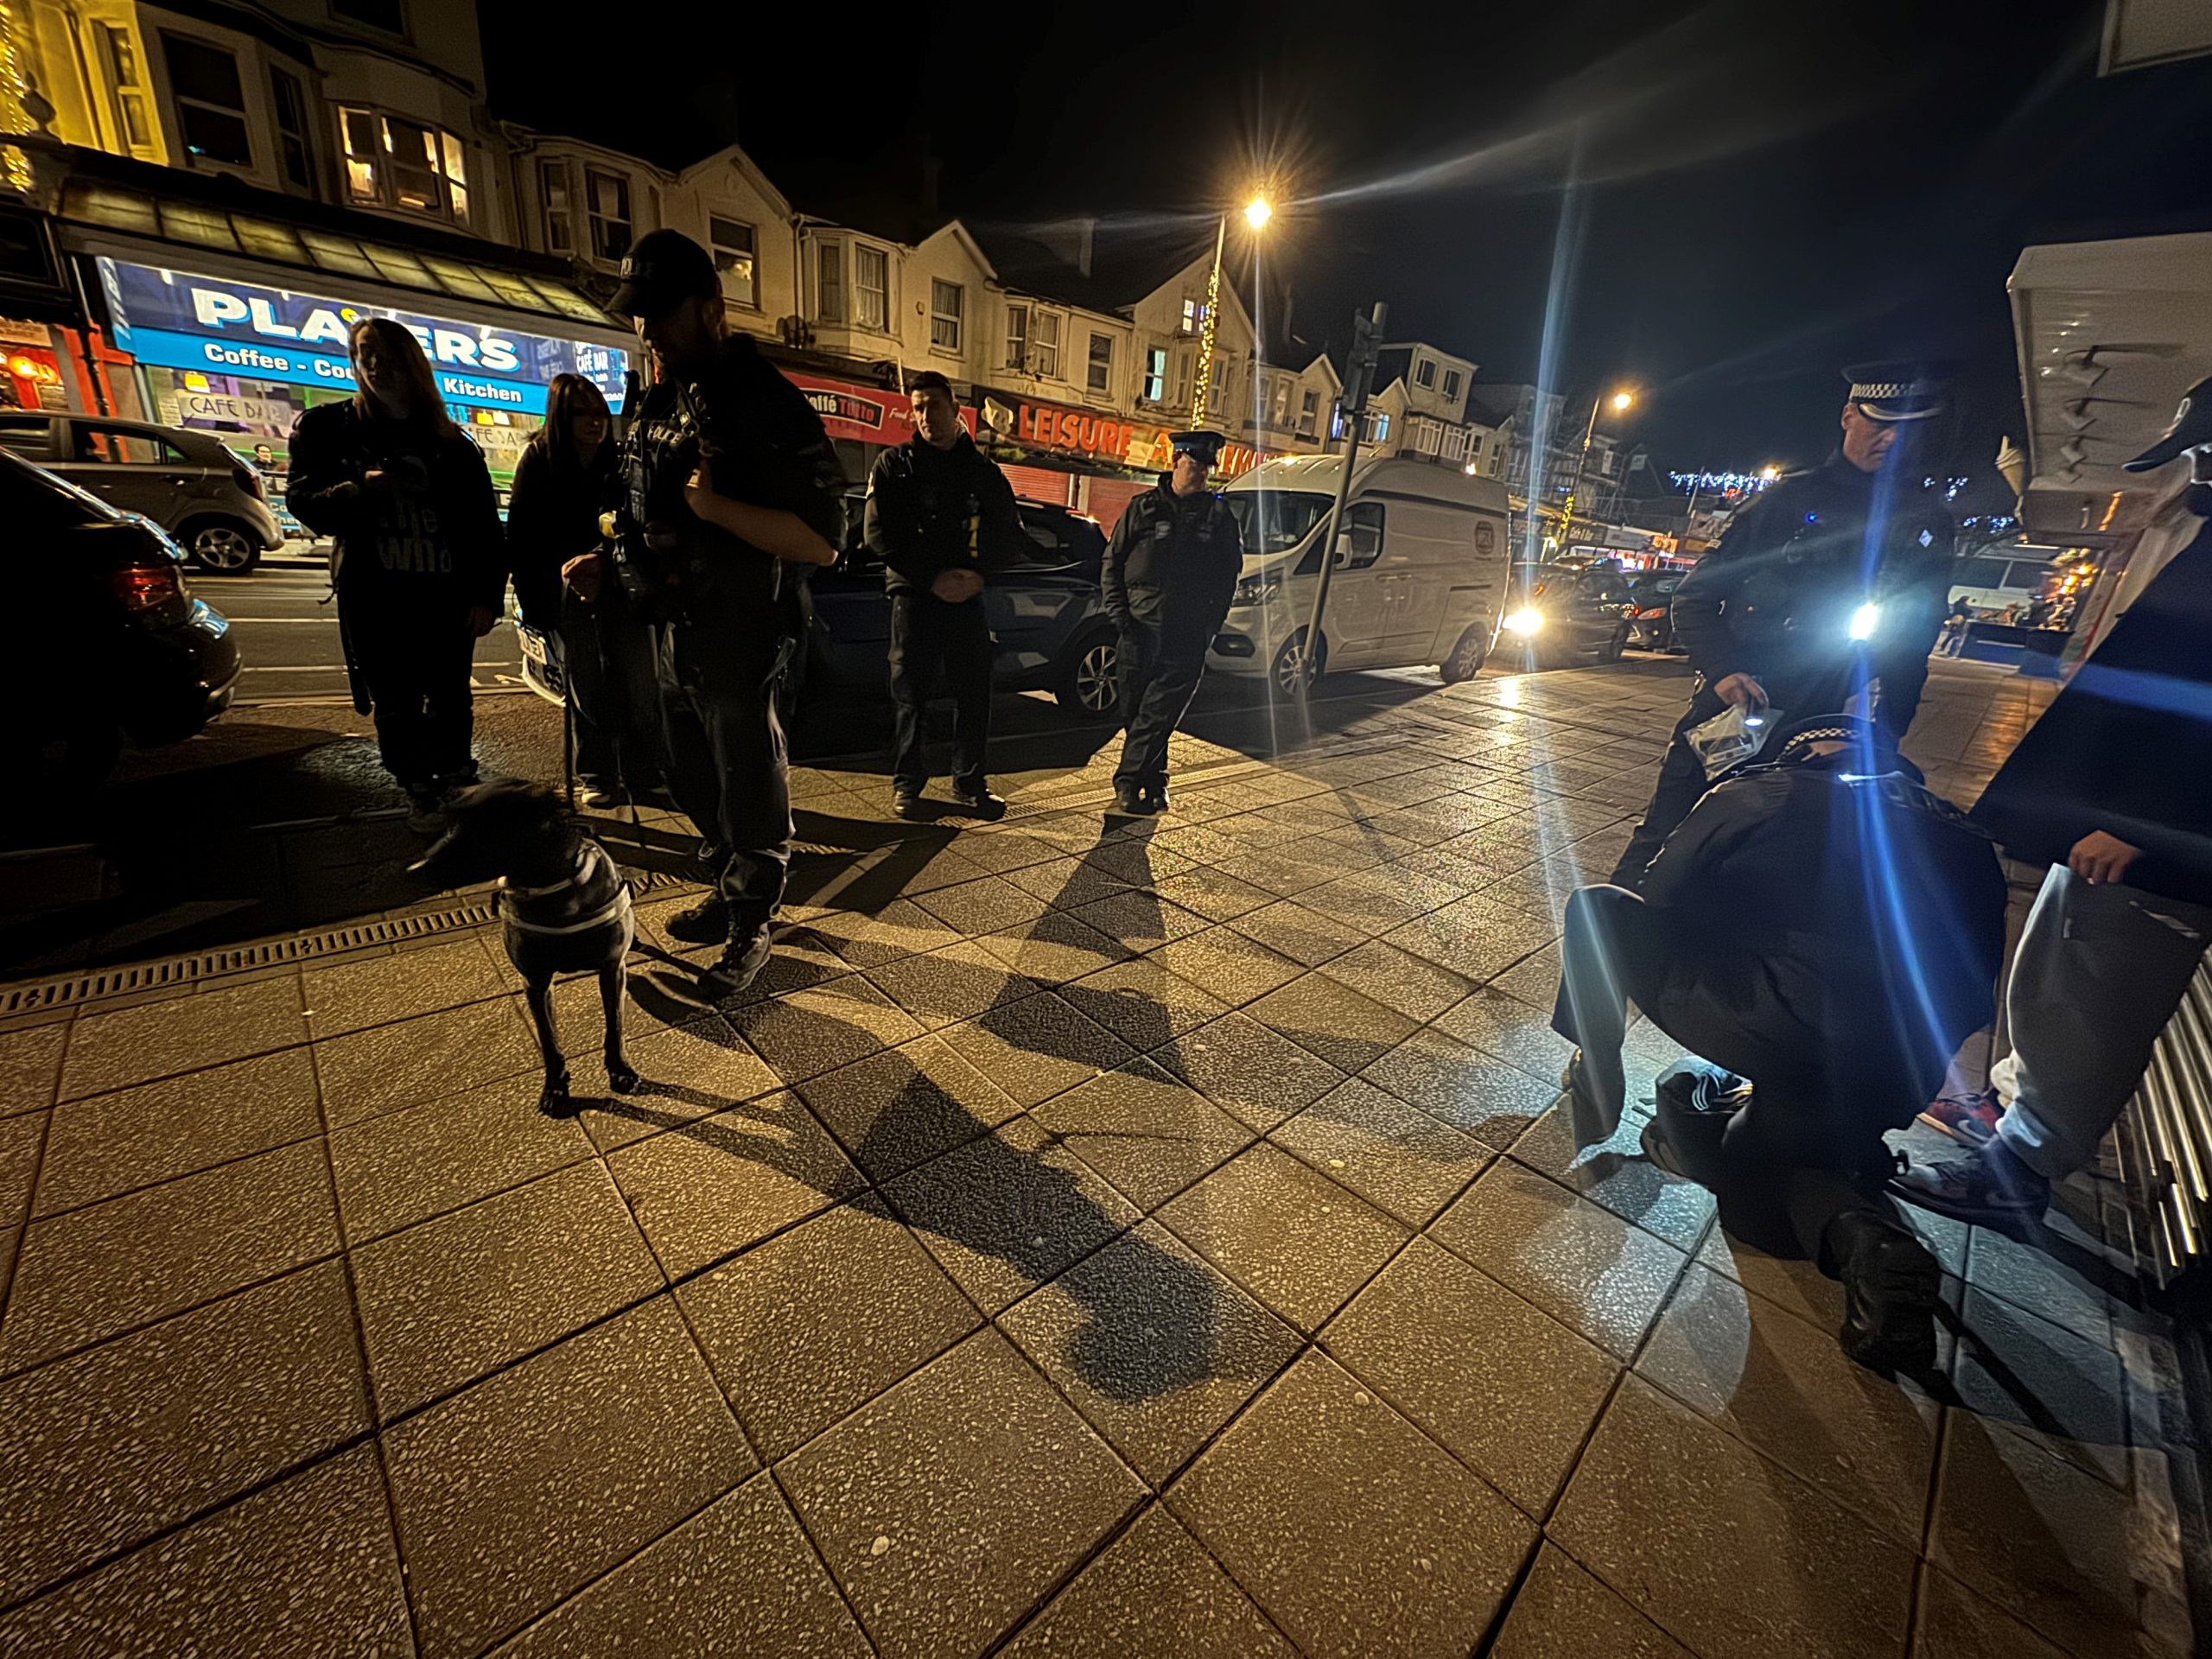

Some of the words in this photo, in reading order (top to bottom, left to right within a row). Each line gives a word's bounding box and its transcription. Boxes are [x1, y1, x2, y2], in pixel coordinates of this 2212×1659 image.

[191, 288, 519, 372] PLAERS
[204, 343, 290, 372] Coffee
[594, 351, 608, 372] BAR
[442, 377, 522, 404] Kitchen
[804, 393, 837, 414] affé
[189, 396, 240, 417] CAFE
[1018, 404, 1134, 457] LEISURE
